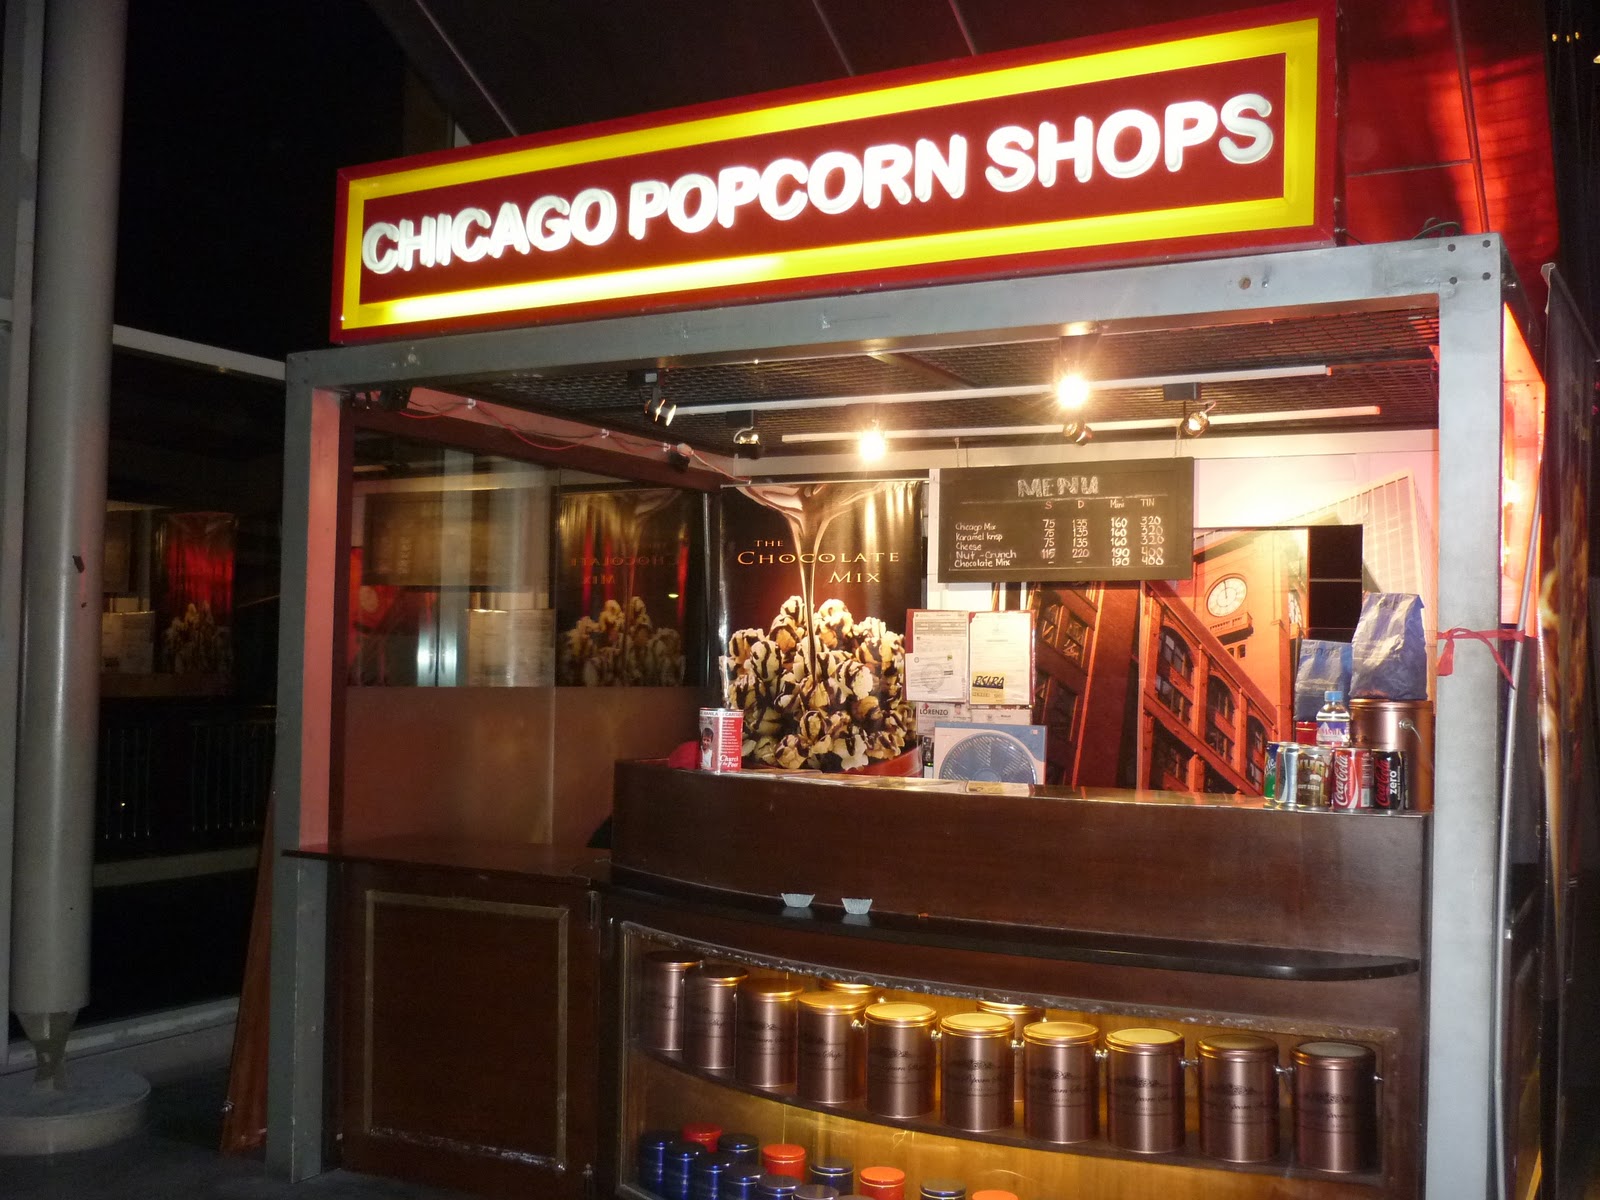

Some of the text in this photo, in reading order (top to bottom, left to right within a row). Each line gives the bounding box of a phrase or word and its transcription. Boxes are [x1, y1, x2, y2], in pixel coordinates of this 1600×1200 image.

[361, 91, 1275, 276] CHICAGO POPCORN SHOPS
[1017, 476, 1099, 498] MENU
[1045, 501, 1053, 510] S
[1078, 500, 1085, 509] D
[1140, 498, 1155, 507] TIN
[955, 523, 982, 535] Chicago
[1042, 519, 1056, 529] 75
[1111, 517, 1128, 528] 160
[1140, 516, 1162, 526] 320
[955, 532, 985, 542] Karamel
[1044, 528, 1055, 538] 75
[1072, 528, 1089, 538] 135
[1111, 527, 1127, 538] 160
[1141, 525, 1164, 536] 320
[955, 535, 1165, 551] Cheese 75 135 160 320
[737, 551, 899, 565] CHOCOLATE
[955, 551, 975, 560] Nut
[1072, 548, 1090, 559] 220
[1112, 547, 1130, 558] 190
[1141, 546, 1164, 558] 400
[954, 556, 1165, 568] Chocolate Mix 190 400
[828, 571, 880, 583] MIX
[919, 708, 949, 716] LORENZO
[1389, 770, 1398, 795] zero
